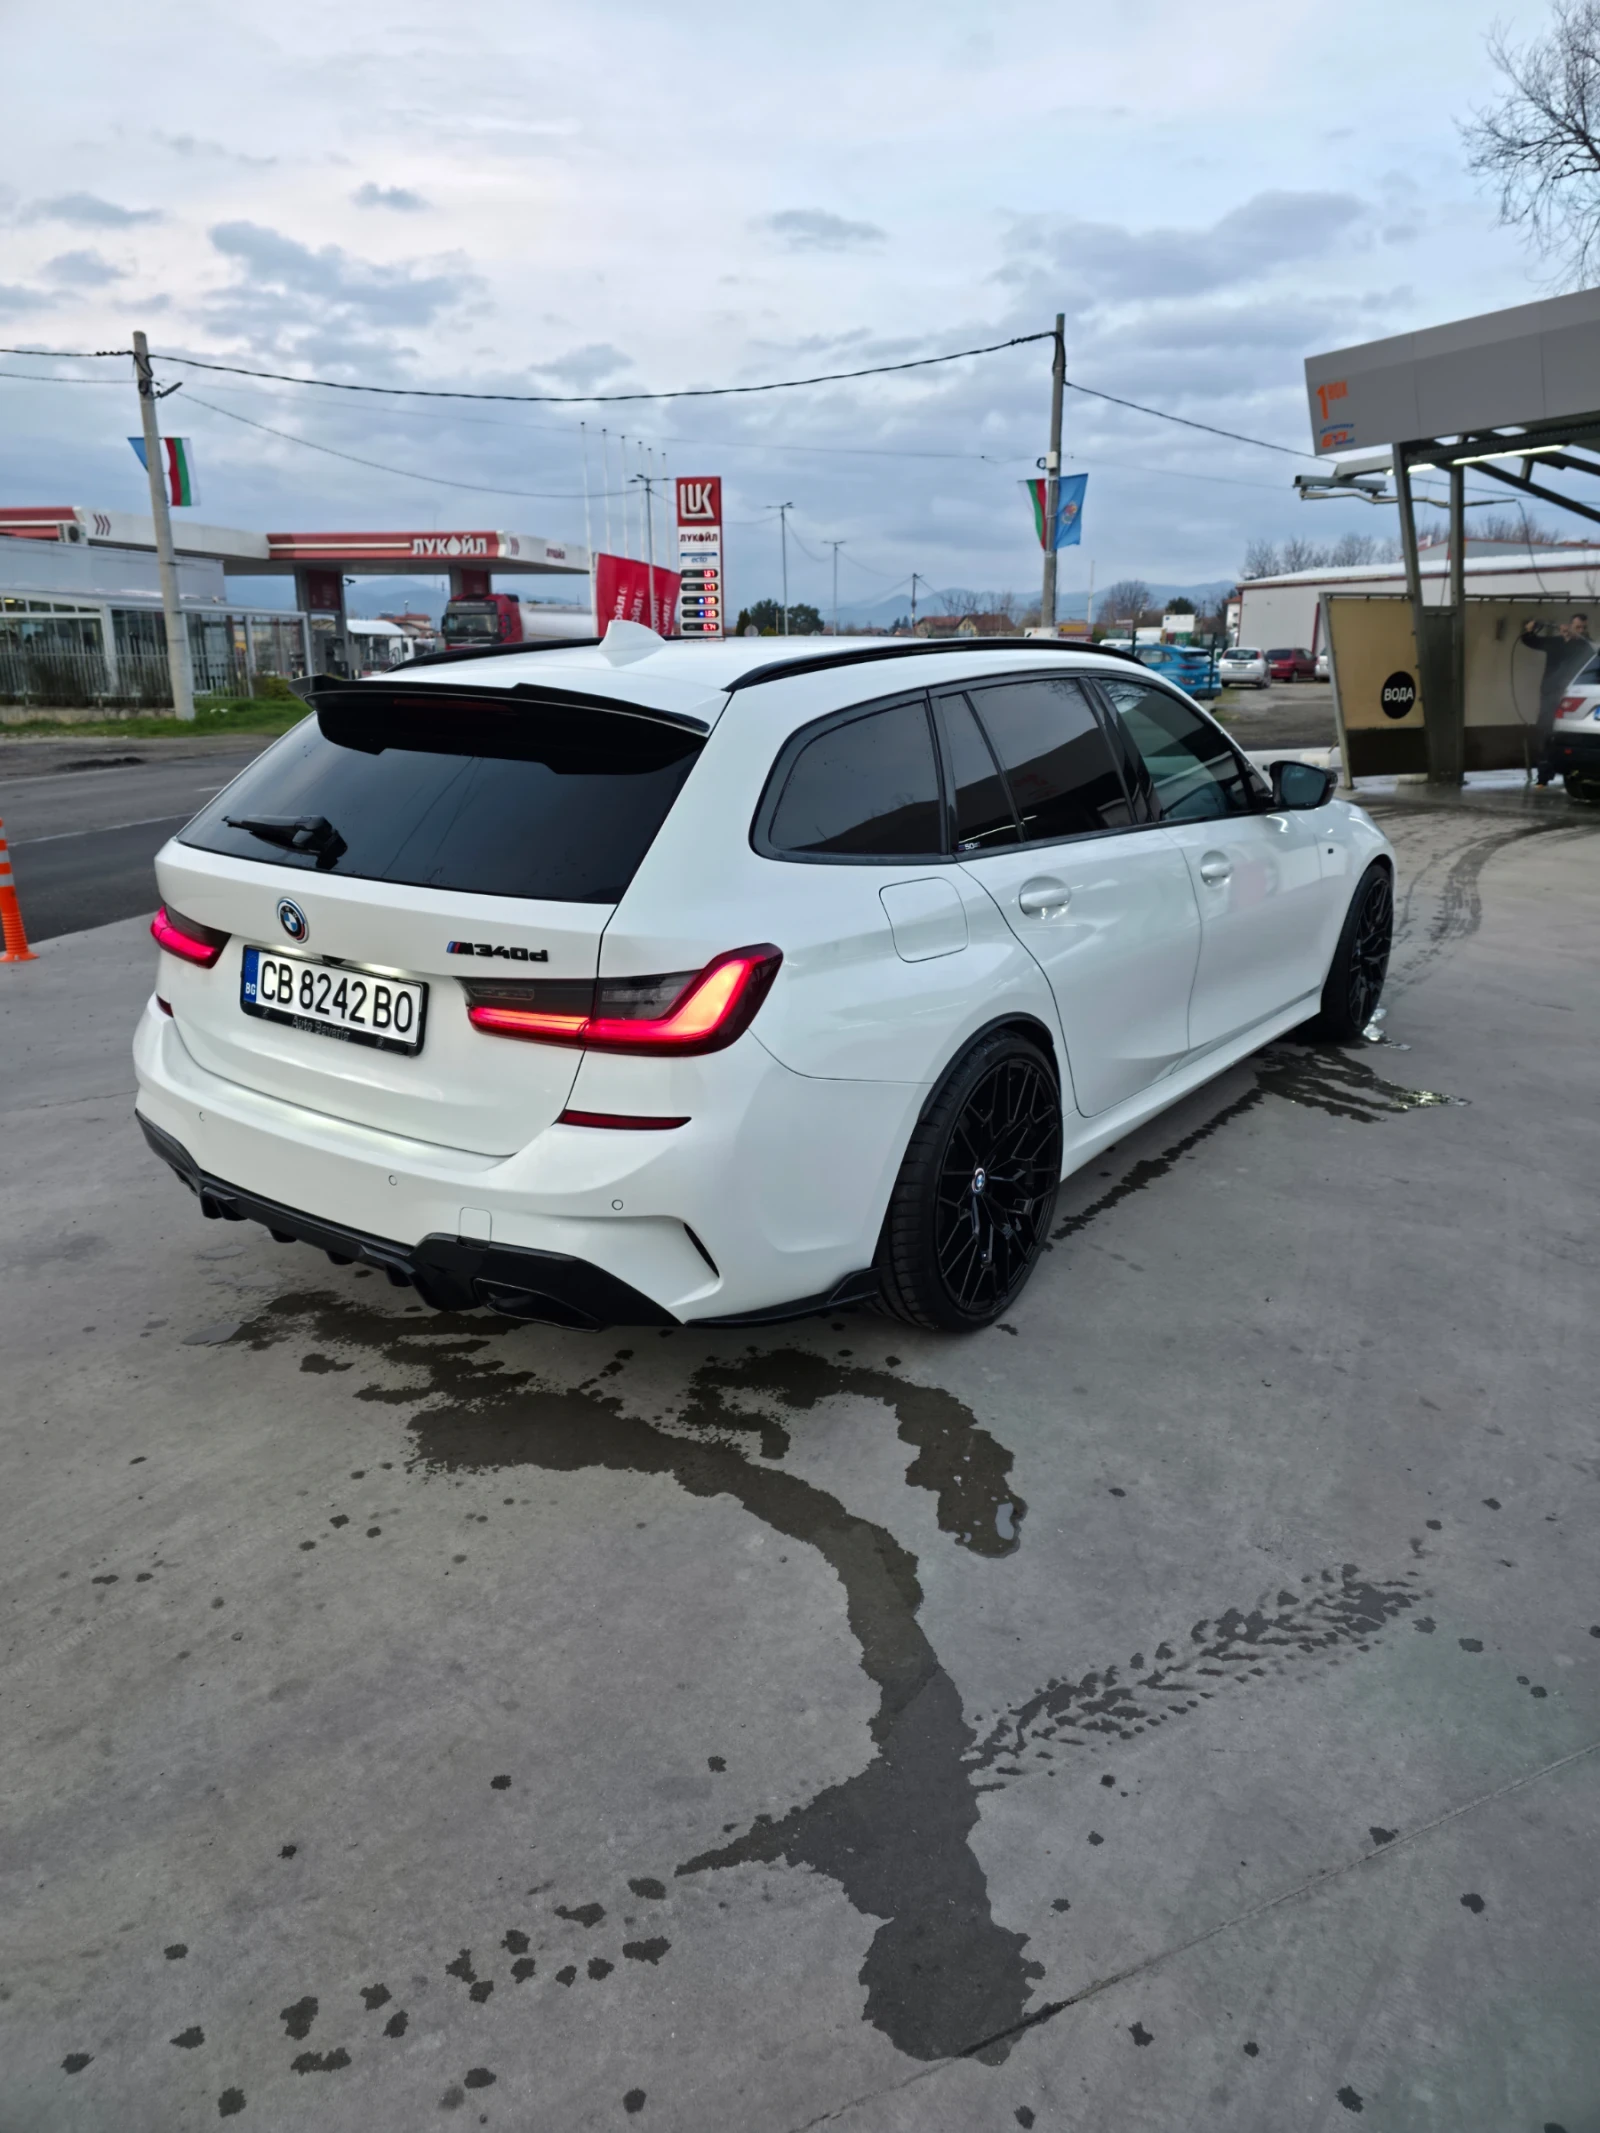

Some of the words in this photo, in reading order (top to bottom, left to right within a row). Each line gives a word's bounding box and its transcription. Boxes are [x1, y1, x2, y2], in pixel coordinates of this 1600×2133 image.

[1316, 384, 1329, 419] 1
[411, 534, 488, 555] ЛУКОЙЛ
[680, 532, 718, 542] ЛУКОЙЛ
[1384, 687, 1413, 702] ВОДА
[245, 983, 256, 995] BG
[260, 960, 293, 1004] CB
[299, 969, 367, 1024] 8242
[372, 985, 413, 1033] BO
[291, 1015, 313, 1033] Auto
